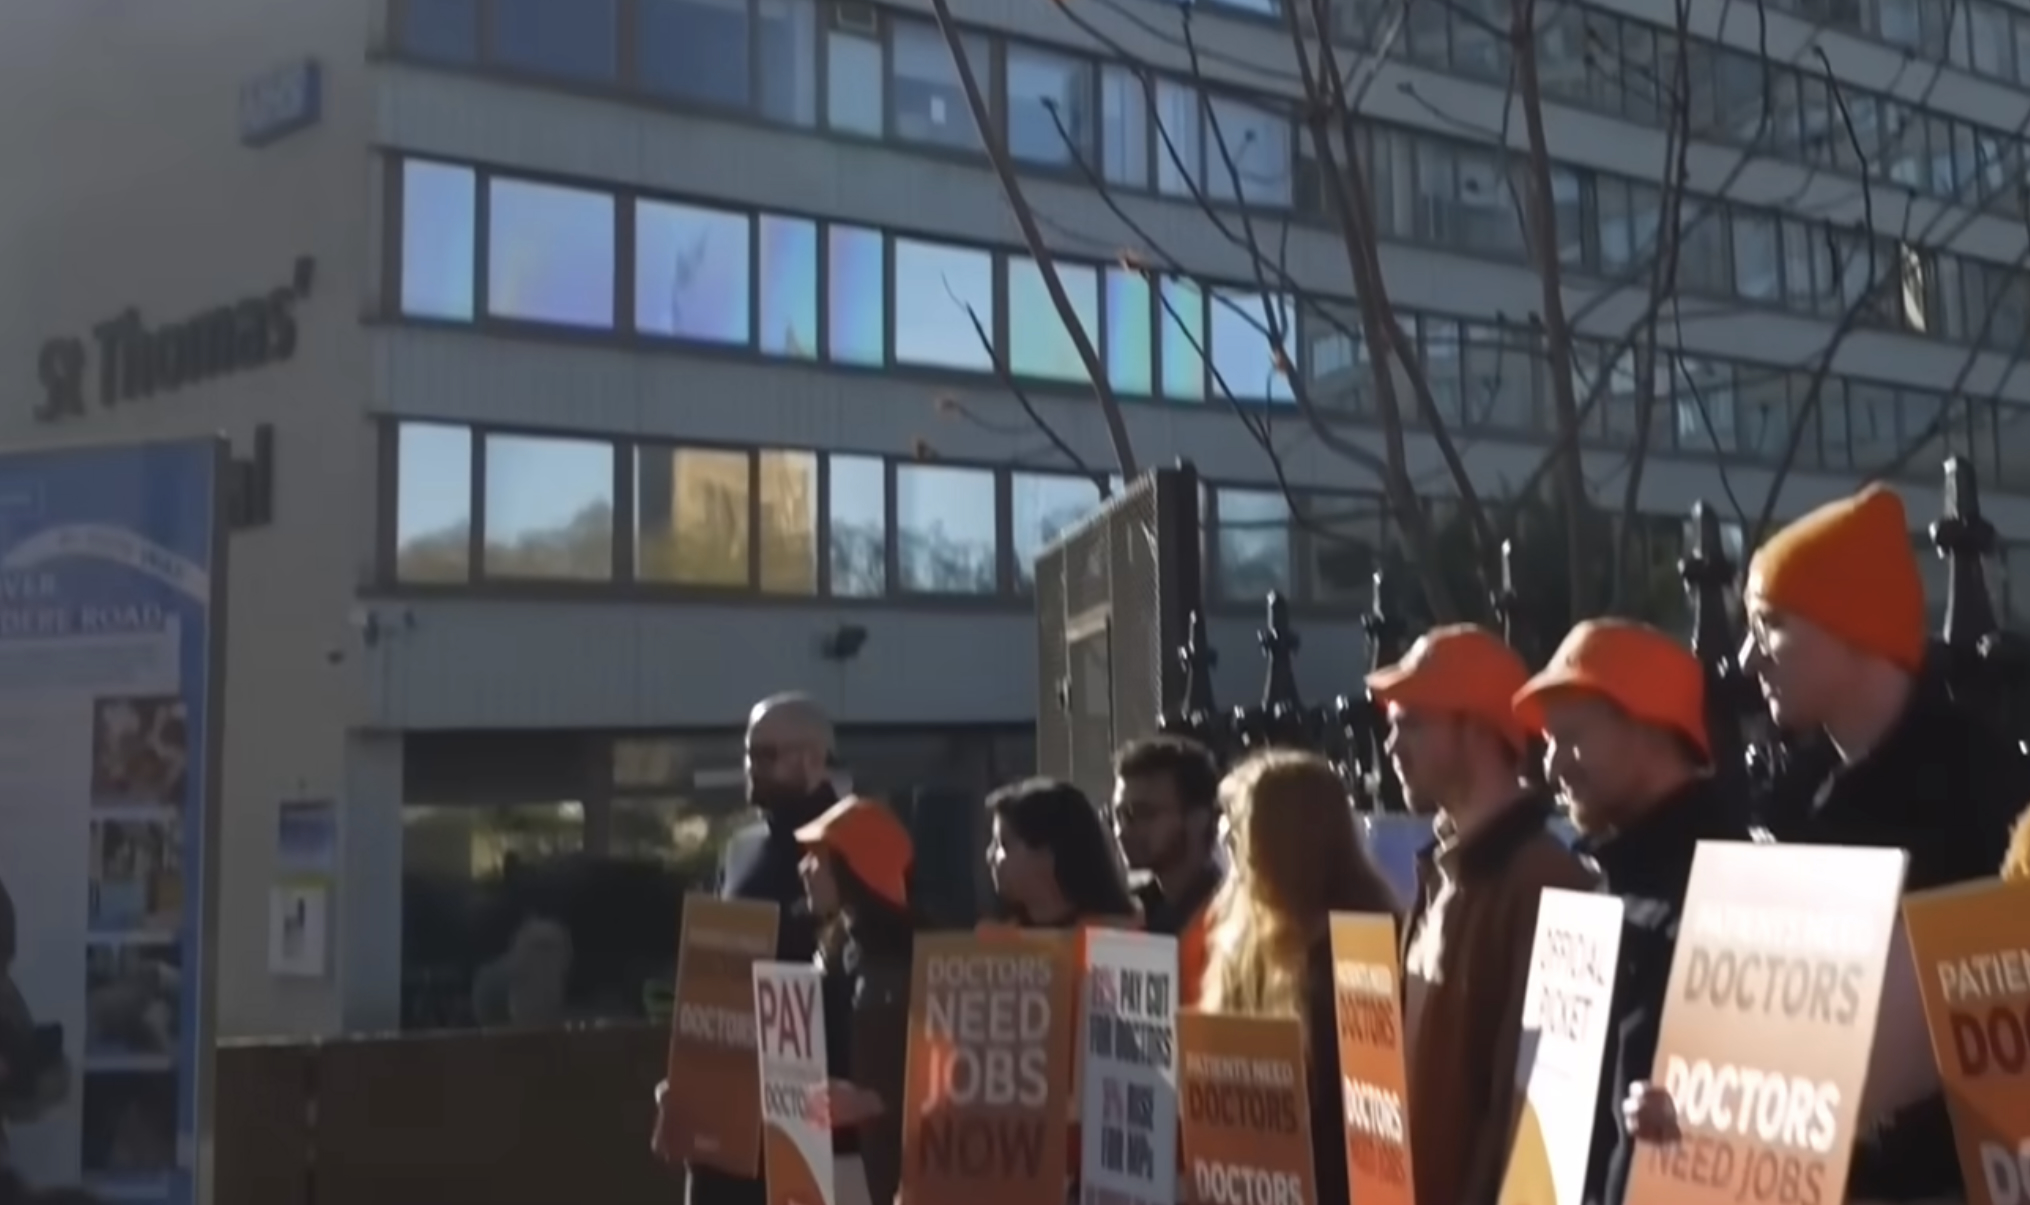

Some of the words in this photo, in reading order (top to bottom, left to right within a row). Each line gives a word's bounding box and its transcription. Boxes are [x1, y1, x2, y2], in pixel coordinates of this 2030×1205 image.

[81, 602, 163, 633] ROAD
[926, 955, 1053, 988] DOCTORS
[1119, 968, 1143, 1015] PAY
[1683, 946, 1864, 1028] DOCTORS
[756, 977, 816, 1061] PAY
[925, 987, 1052, 1043] NEED
[1948, 1004, 2030, 1077] DO
[920, 1044, 1050, 1114] JOBS
[1187, 1079, 1299, 1134] DOCTORS
[1663, 1052, 1842, 1154] DOCTORS
[919, 1114, 1045, 1180] NOW
[1193, 1154, 1304, 1205] DOCTORS
[1647, 1131, 1736, 1190] NEED
[1736, 1146, 1828, 1205] JOBS
